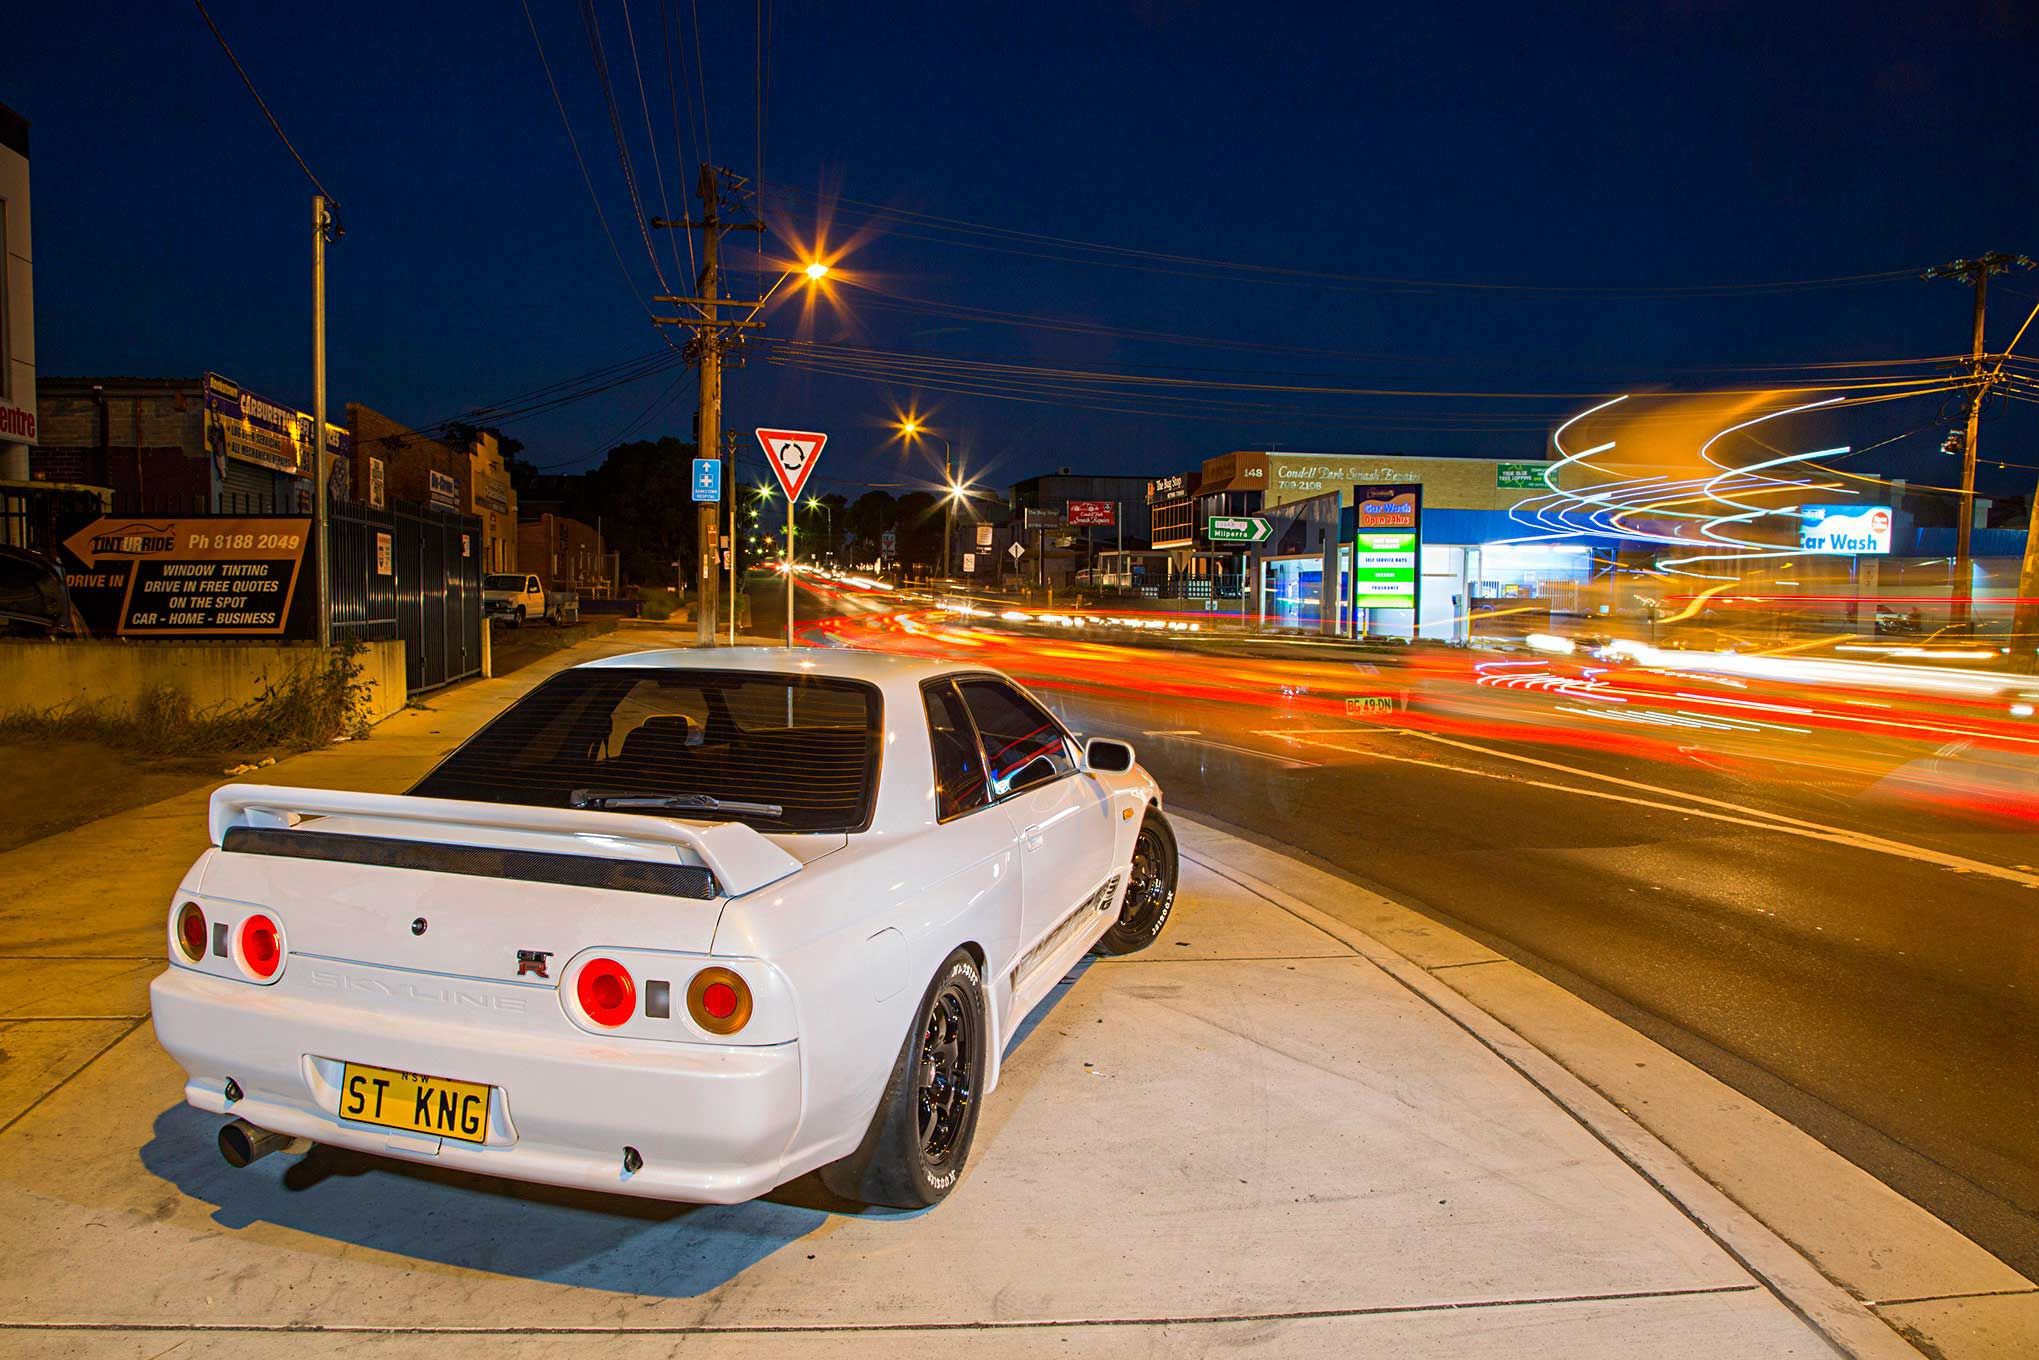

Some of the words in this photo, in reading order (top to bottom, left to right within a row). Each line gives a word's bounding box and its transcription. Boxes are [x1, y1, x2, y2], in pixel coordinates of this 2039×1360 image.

[1244, 468, 1263, 478] 148
[1364, 514, 1386, 526] Open
[1214, 530, 1248, 538] Milperra
[188, 534, 210, 549] Ph
[214, 534, 254, 550] 8188
[257, 534, 300, 550] 2049
[1830, 533, 1877, 550] Wash
[163, 564, 216, 576] WINDOW
[221, 564, 269, 576] TINTING
[66, 574, 106, 587] DRIVE
[108, 574, 125, 587] IN
[143, 580, 182, 593] DRIVE
[183, 580, 197, 593] IN
[199, 580, 231, 593] FREE
[232, 580, 280, 593] QUOTES
[169, 596, 188, 608] ON
[190, 596, 214, 608] THE
[215, 596, 248, 608] SPOT
[132, 612, 158, 625] CAR
[168, 612, 206, 625] HOME
[215, 612, 276, 625] BUSINESS
[312, 970, 528, 1016] SKYLINE
[347, 1075, 390, 1119] ST
[414, 1085, 481, 1135] KNG
